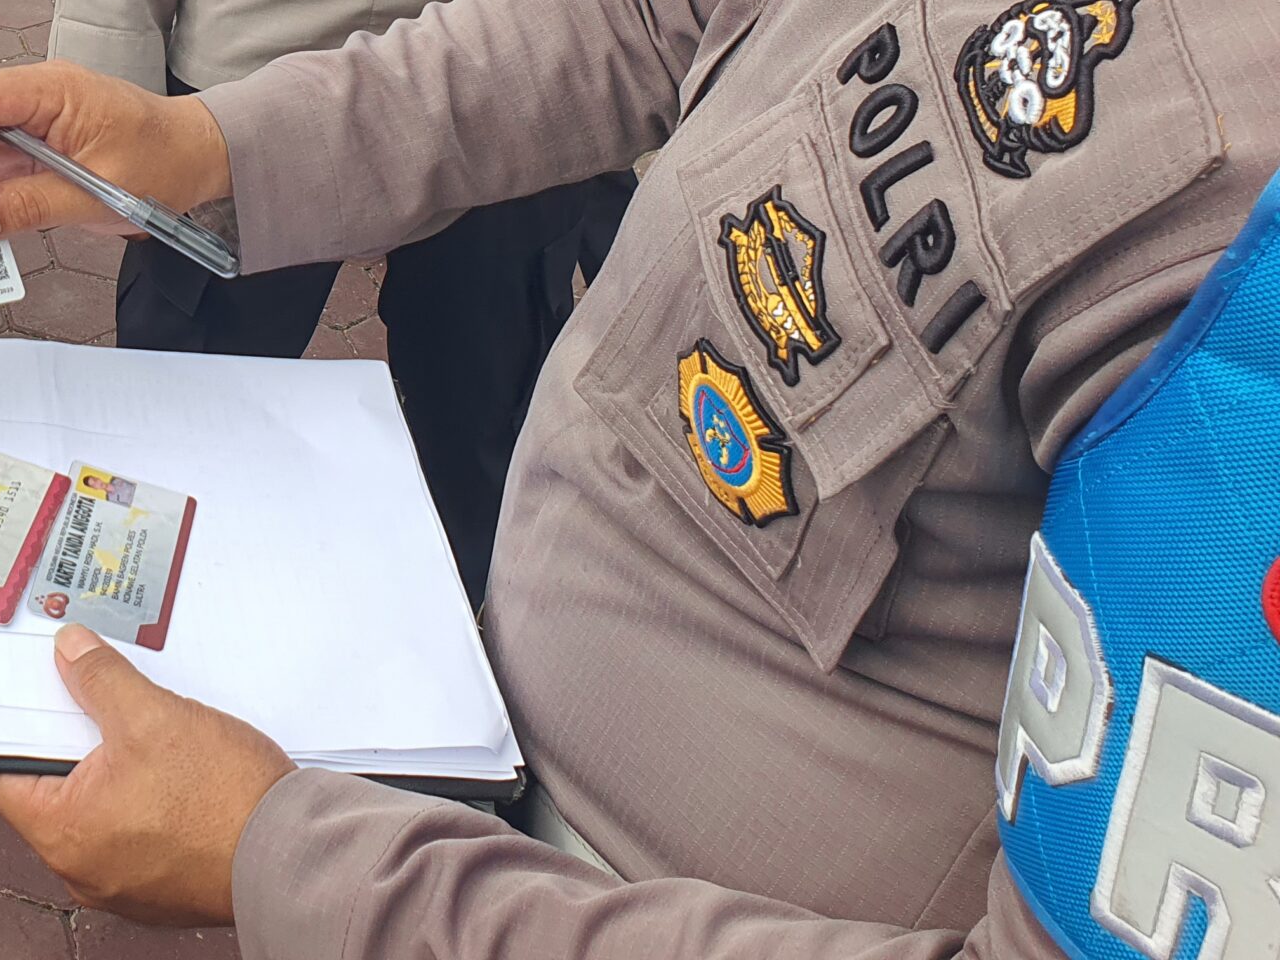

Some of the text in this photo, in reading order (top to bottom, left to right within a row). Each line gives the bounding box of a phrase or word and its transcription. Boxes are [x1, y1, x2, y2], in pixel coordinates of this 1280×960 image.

[836, 22, 987, 354] POLRI
[52, 494, 96, 588] KARTU TANDA ANGGOTA
[110, 578, 124, 600] BAMIN
[122, 529, 136, 553] POLRES
[121, 527, 149, 604] KONAWE SELATAN POLDA
[76, 565, 90, 589] WAHYU
[87, 565, 102, 592] BRIGPOL
[132, 582, 147, 607] SULTRA
